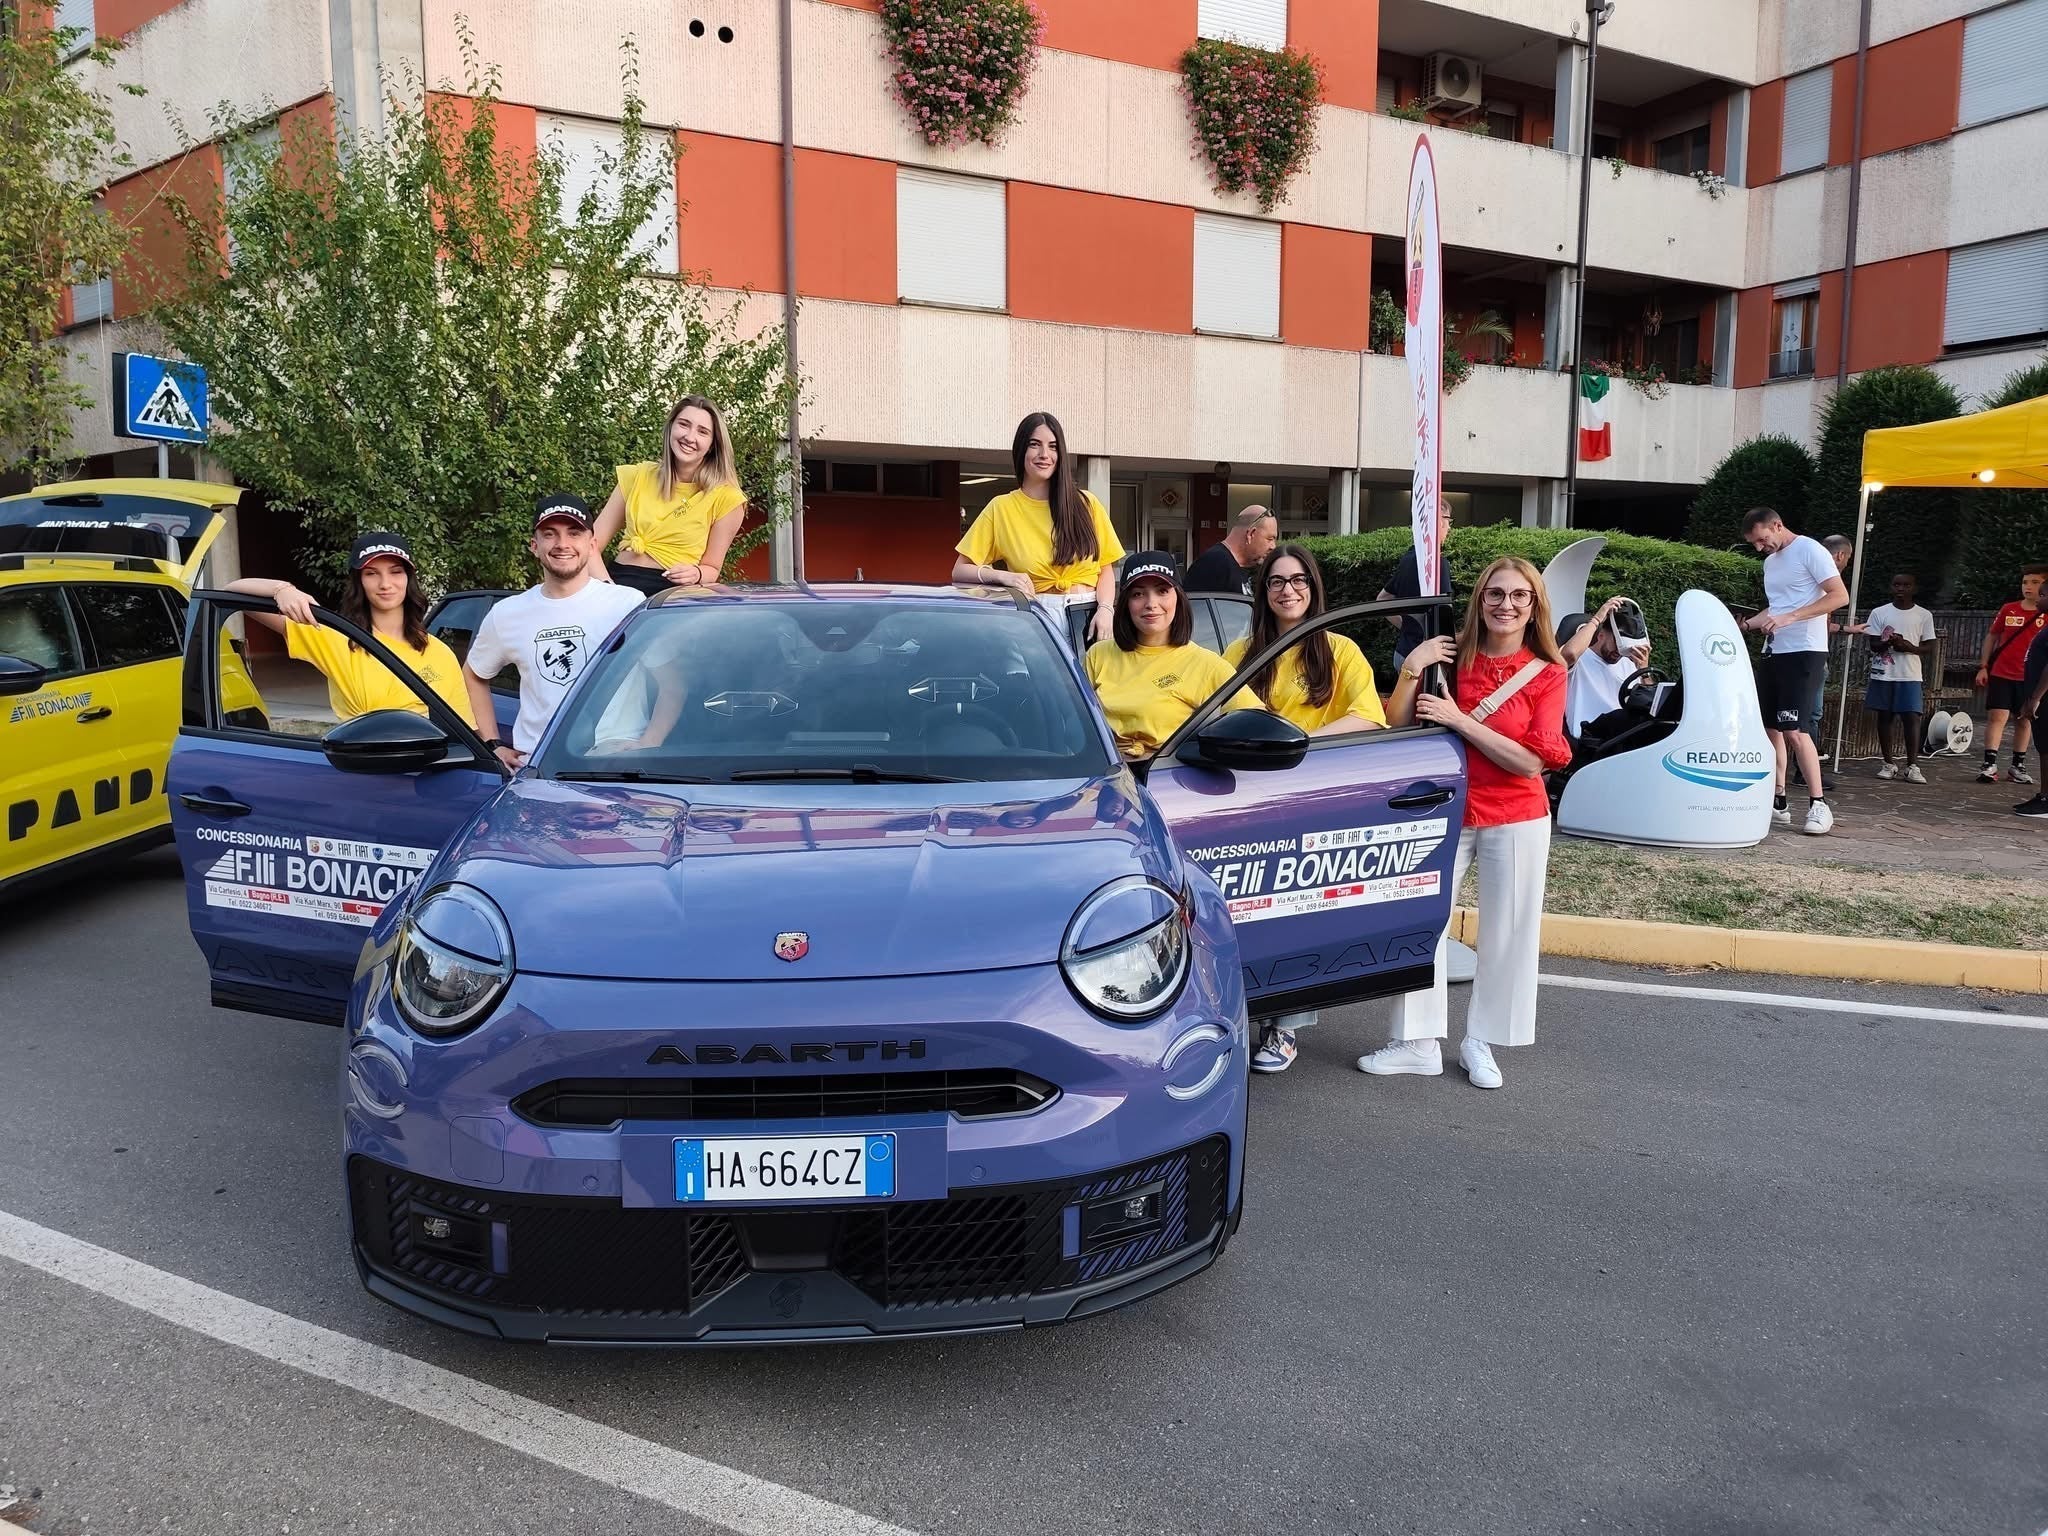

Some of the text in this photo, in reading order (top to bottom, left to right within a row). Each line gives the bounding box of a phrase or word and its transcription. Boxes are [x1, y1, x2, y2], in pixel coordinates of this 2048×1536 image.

[538, 505, 587, 521] ABARTH
[358, 543, 410, 560] ABARTH
[1126, 563, 1174, 579] ABARTH
[537, 627, 582, 639] ABARTH
[37, 694, 87, 716] BONACINI
[1686, 751, 1762, 764] READY2GO
[8, 762, 169, 842] PAND
[196, 828, 302, 851] CONCESSIONARIA
[1332, 832, 1345, 845] FIAT
[1348, 830, 1361, 843] FIAT
[338, 842, 351, 857] FIAT
[355, 844, 368, 859] FIAT
[1273, 841, 1416, 890] BONACINI
[294, 896, 303, 904] Via
[1276, 897, 1286, 905] Via
[645, 1039, 926, 1065] ABARTH
[707, 1149, 862, 1188] HA 664CZ
